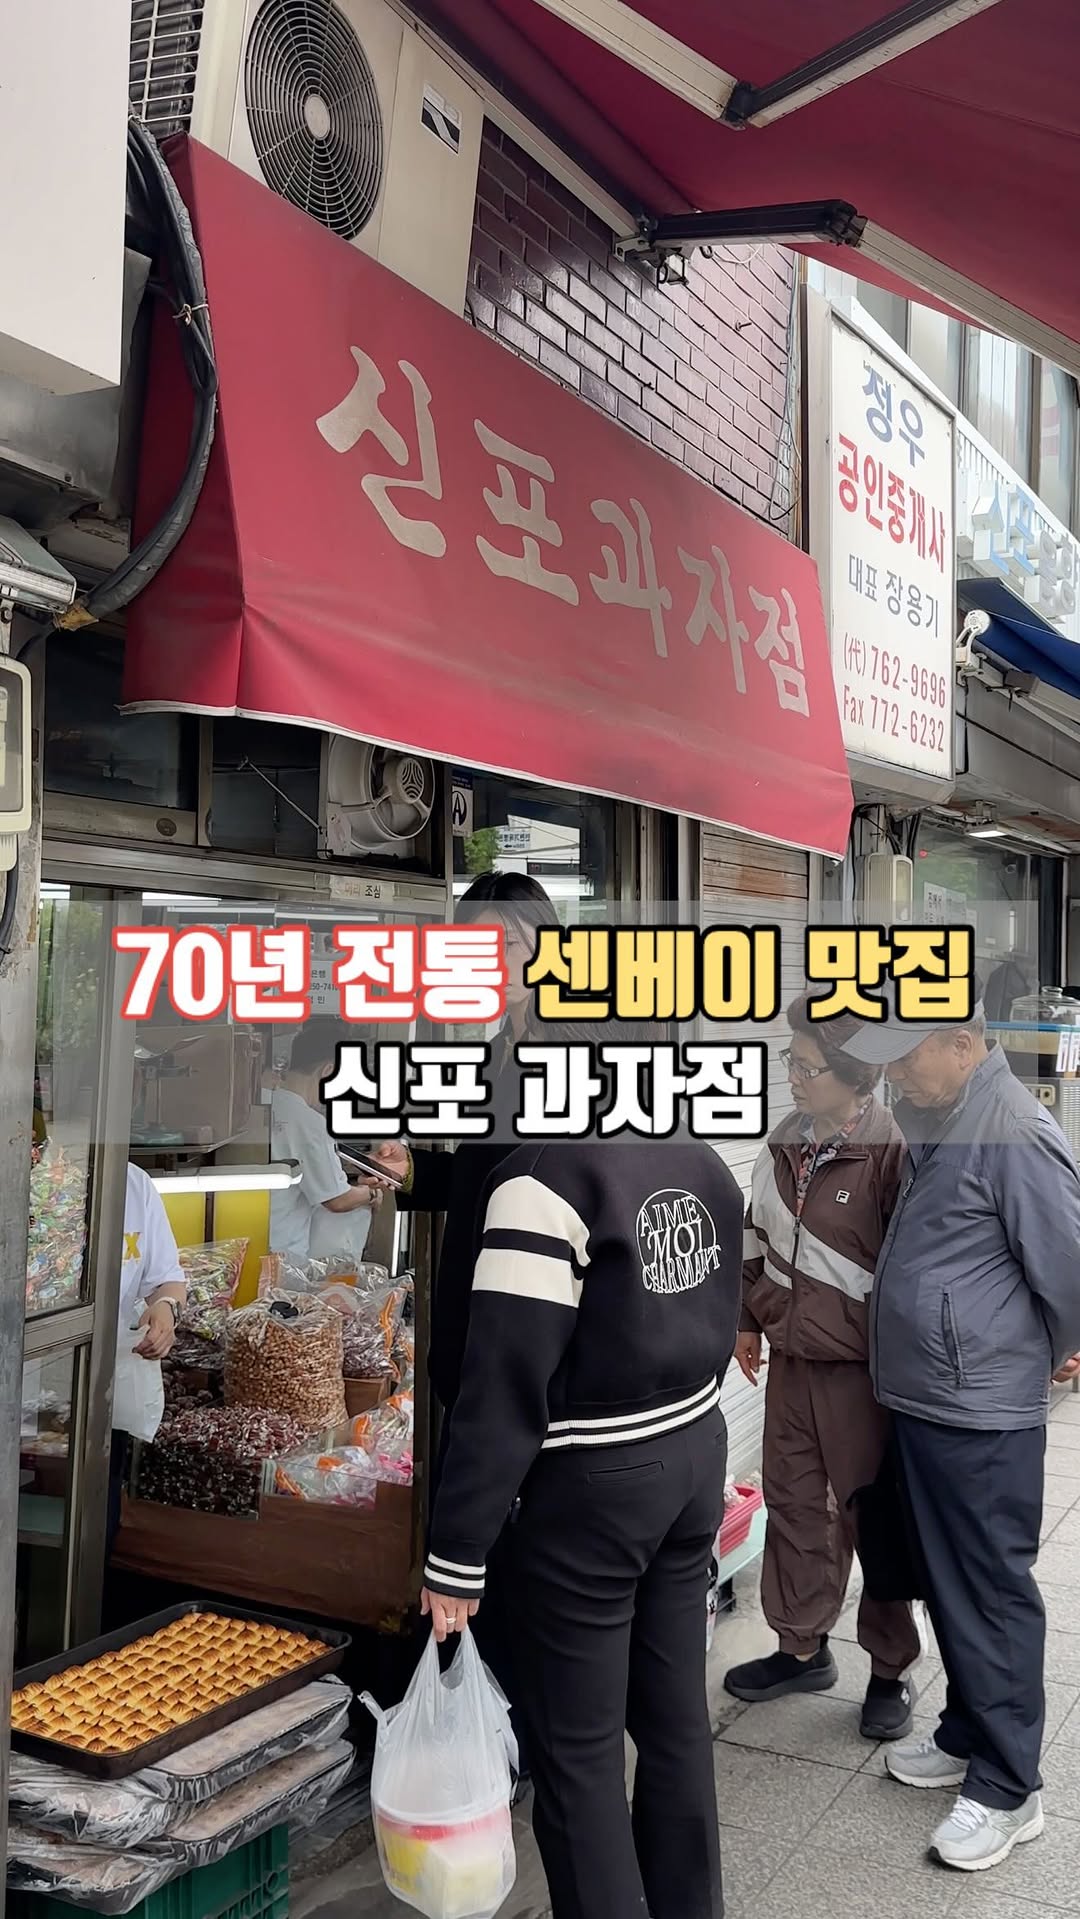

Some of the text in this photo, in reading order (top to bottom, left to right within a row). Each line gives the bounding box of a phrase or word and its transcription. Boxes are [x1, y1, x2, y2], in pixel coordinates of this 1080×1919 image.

[862, 366, 925, 468] 정우
[315, 345, 811, 719] 신포과자점
[837, 432, 945, 574] 공인중개사
[848, 553, 939, 639] 대표 장용기
[843, 631, 946, 709] (代) 762-9696
[843, 684, 944, 752] Fax 772-6232
[365, 884, 381, 899] 조심
[640, 1195, 701, 1237] AIME
[647, 1219, 703, 1266] MOI
[642, 1245, 721, 1294] CHARMANT
